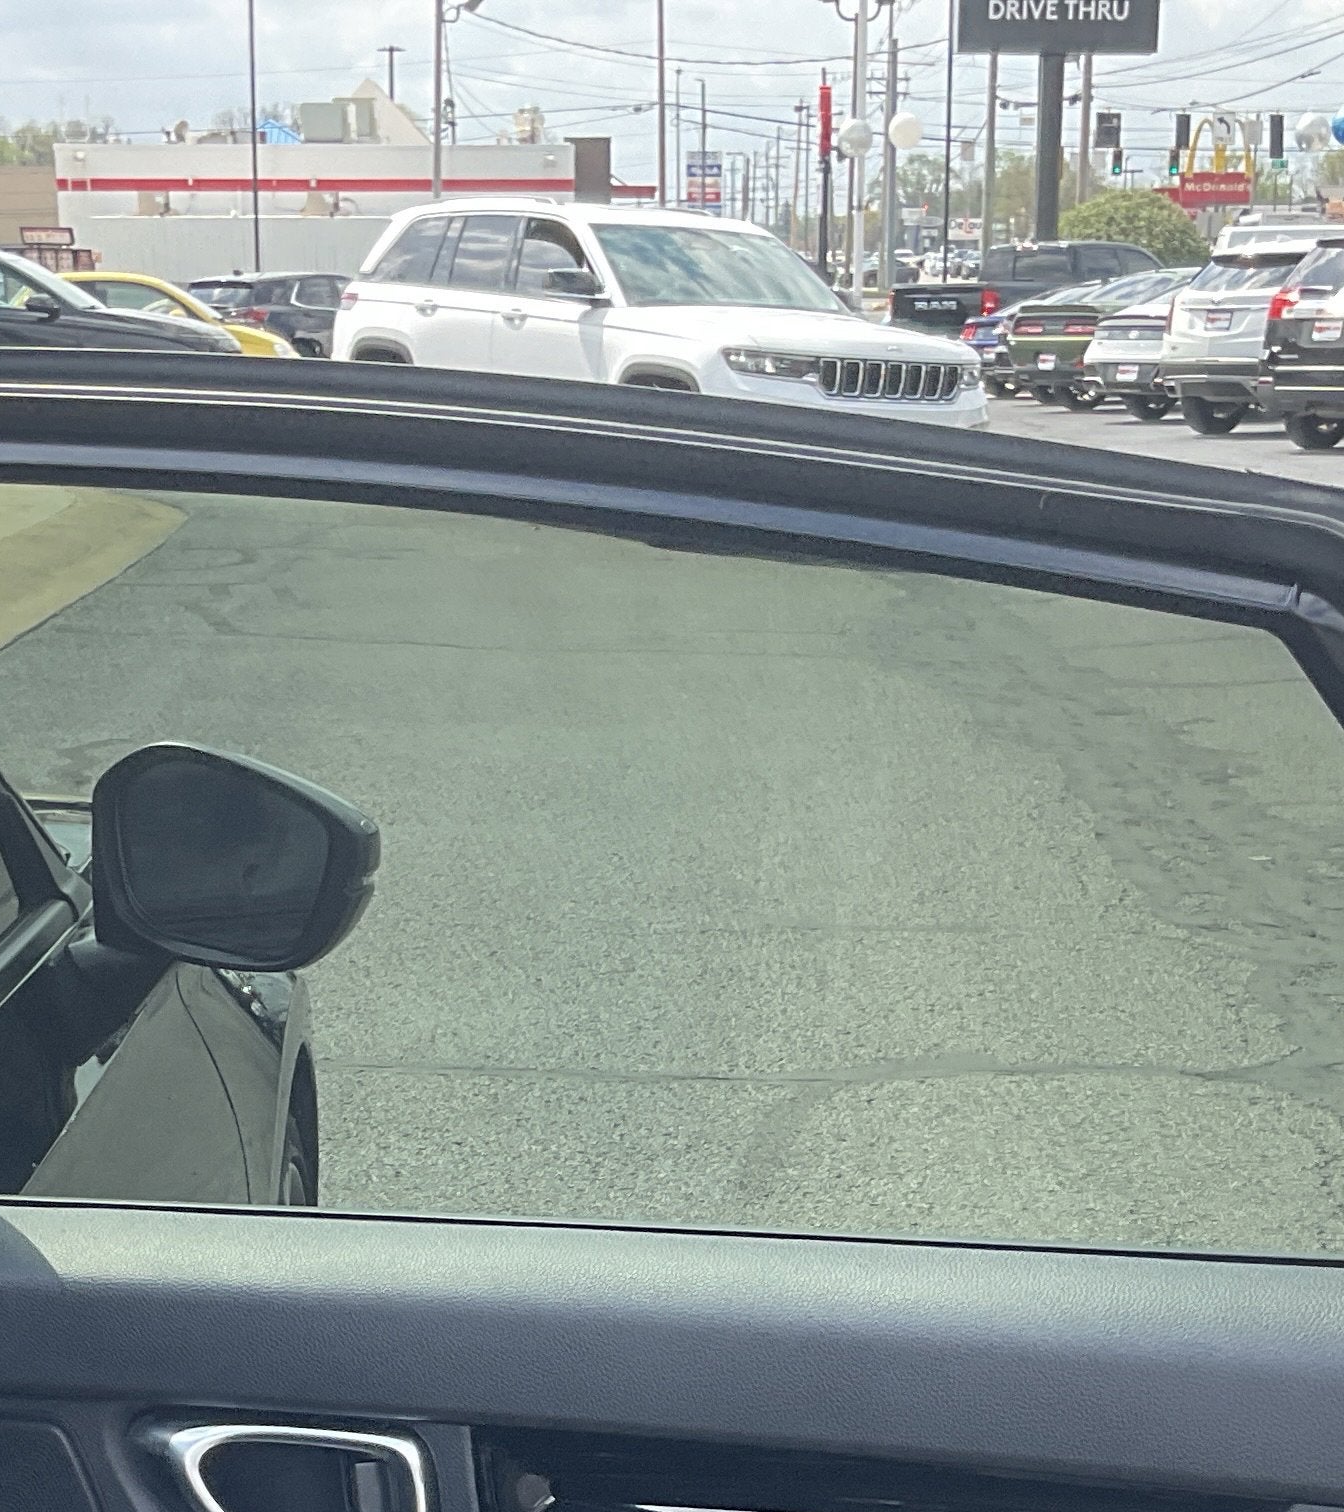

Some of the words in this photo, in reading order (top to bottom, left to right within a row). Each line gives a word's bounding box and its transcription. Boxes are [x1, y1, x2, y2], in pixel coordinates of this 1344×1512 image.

[988, 0, 1058, 20] DRIVE
[1064, 0, 1130, 20] THRU
[914, 300, 957, 311] RAM
